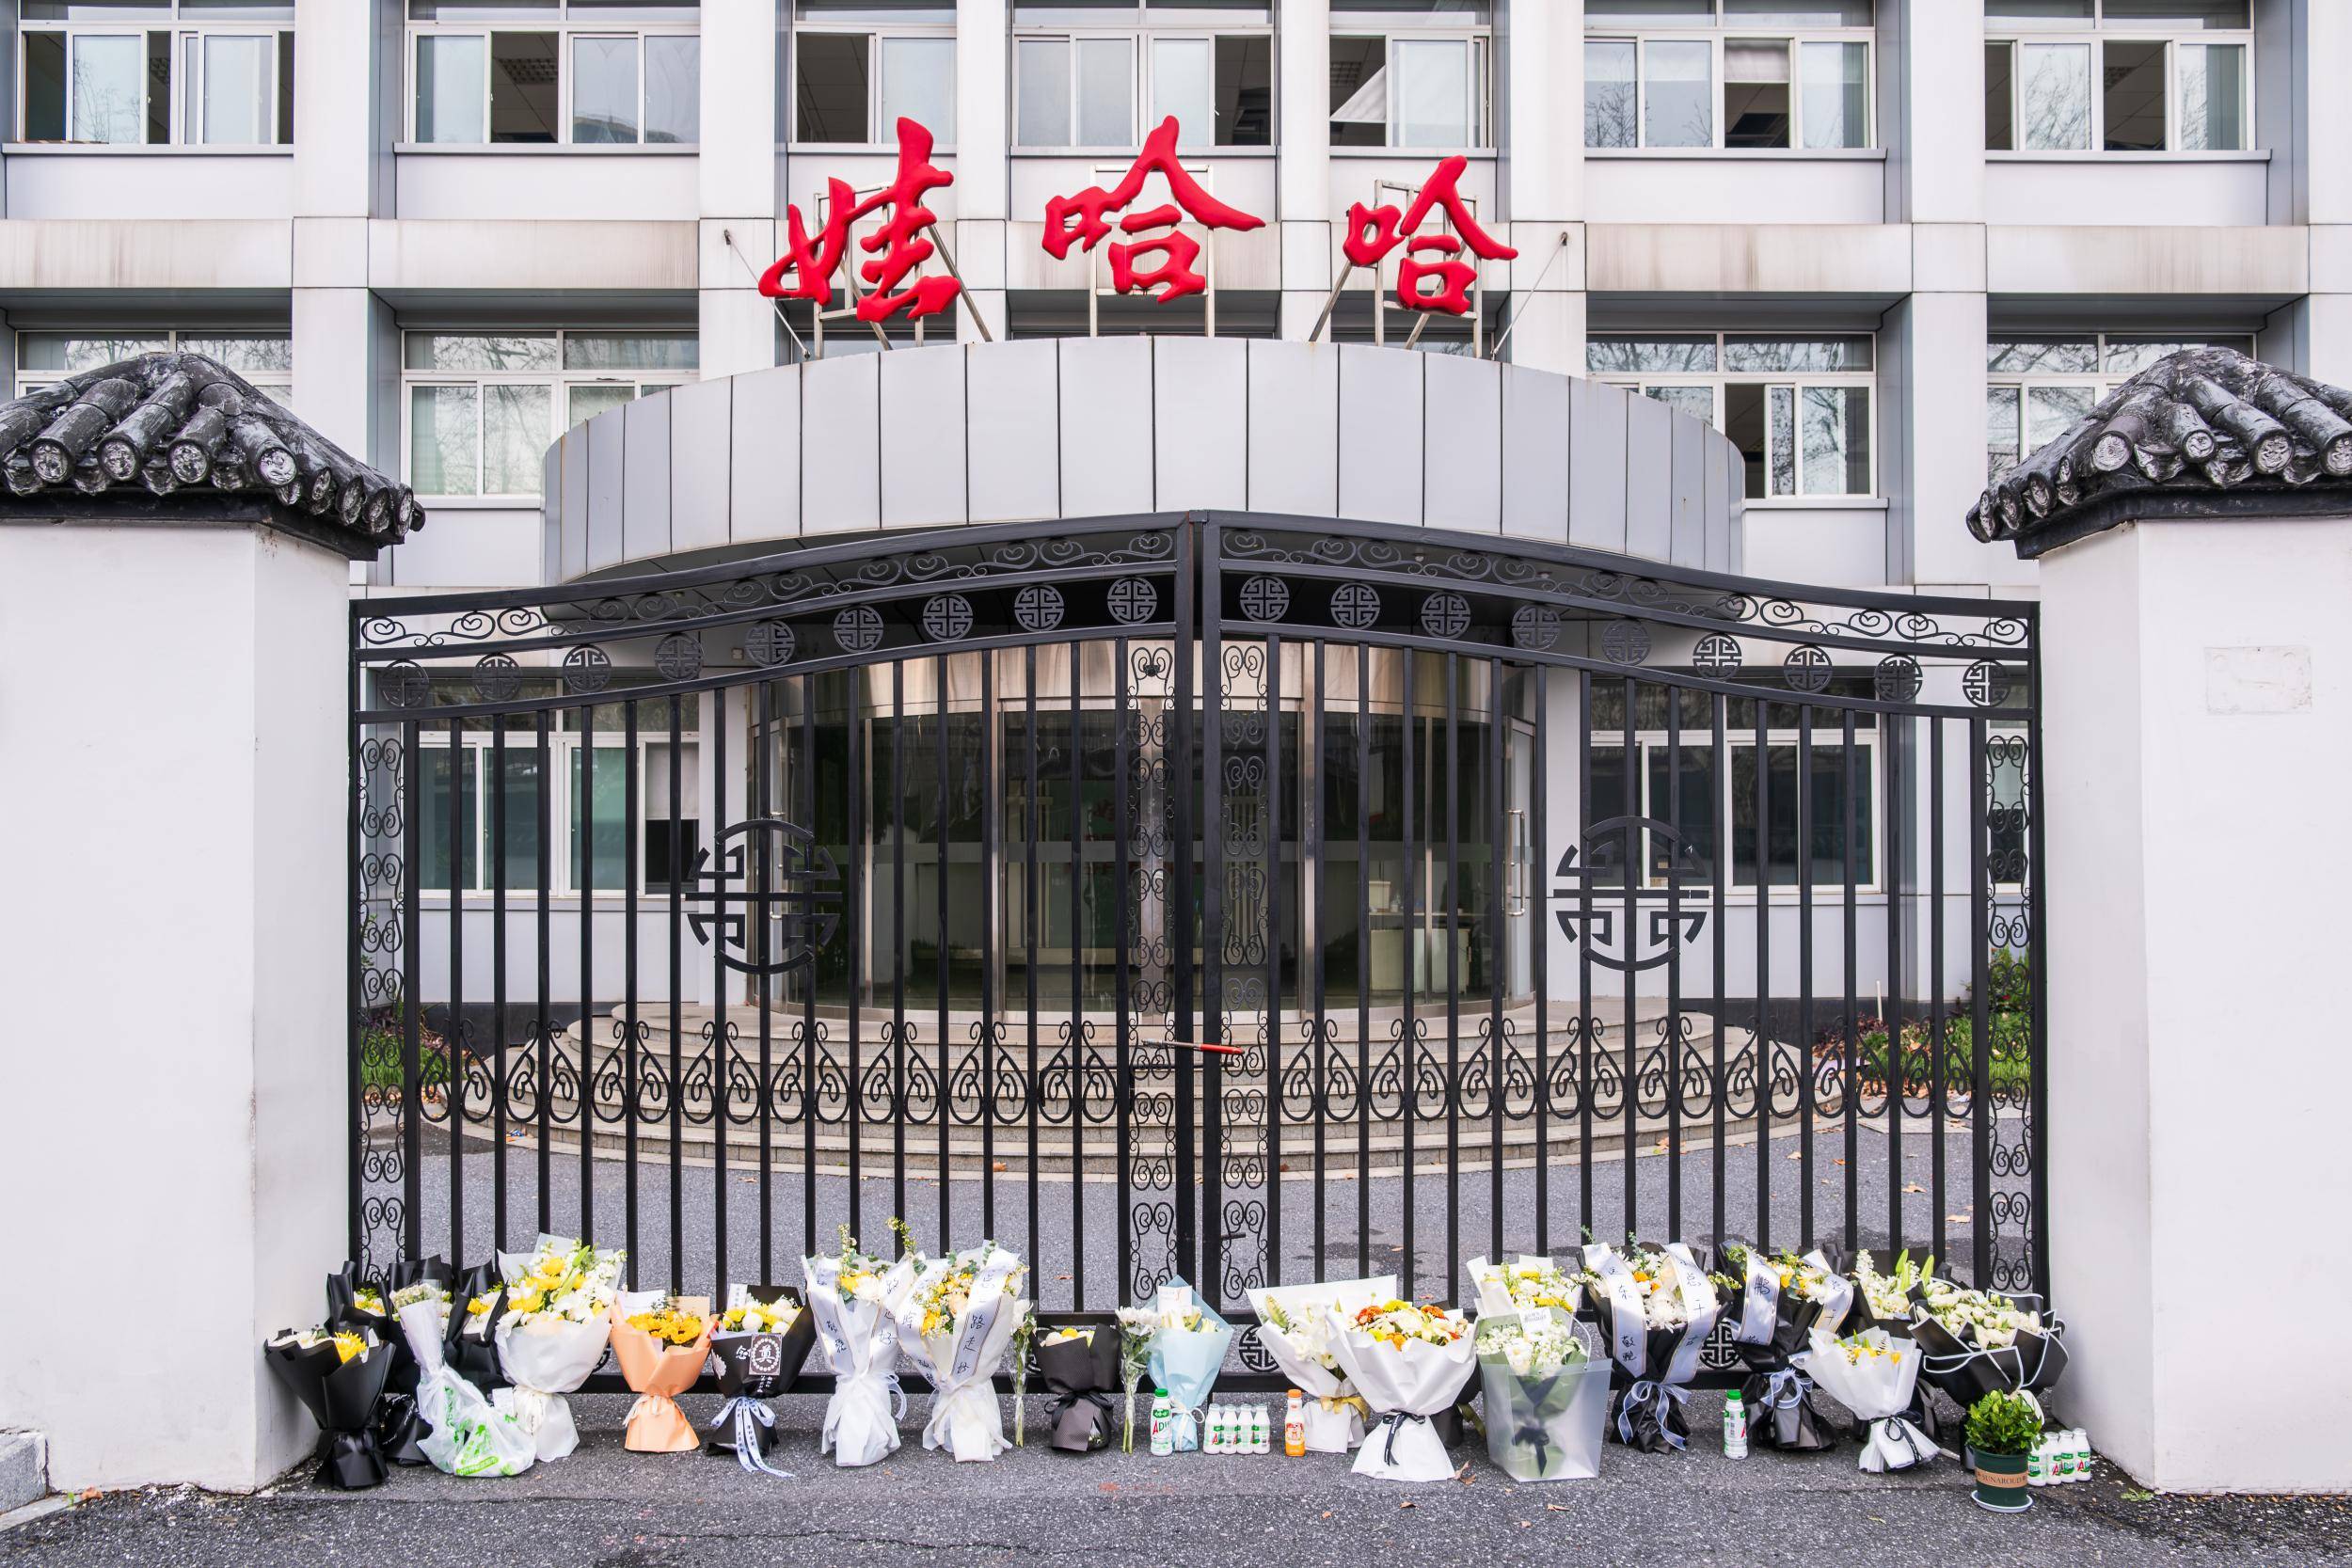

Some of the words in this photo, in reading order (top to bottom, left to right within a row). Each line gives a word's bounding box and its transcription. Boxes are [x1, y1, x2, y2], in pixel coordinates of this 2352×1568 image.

[758, 116, 1519, 322] 娃哈哈
[755, 1344, 776, 1364] 奠
